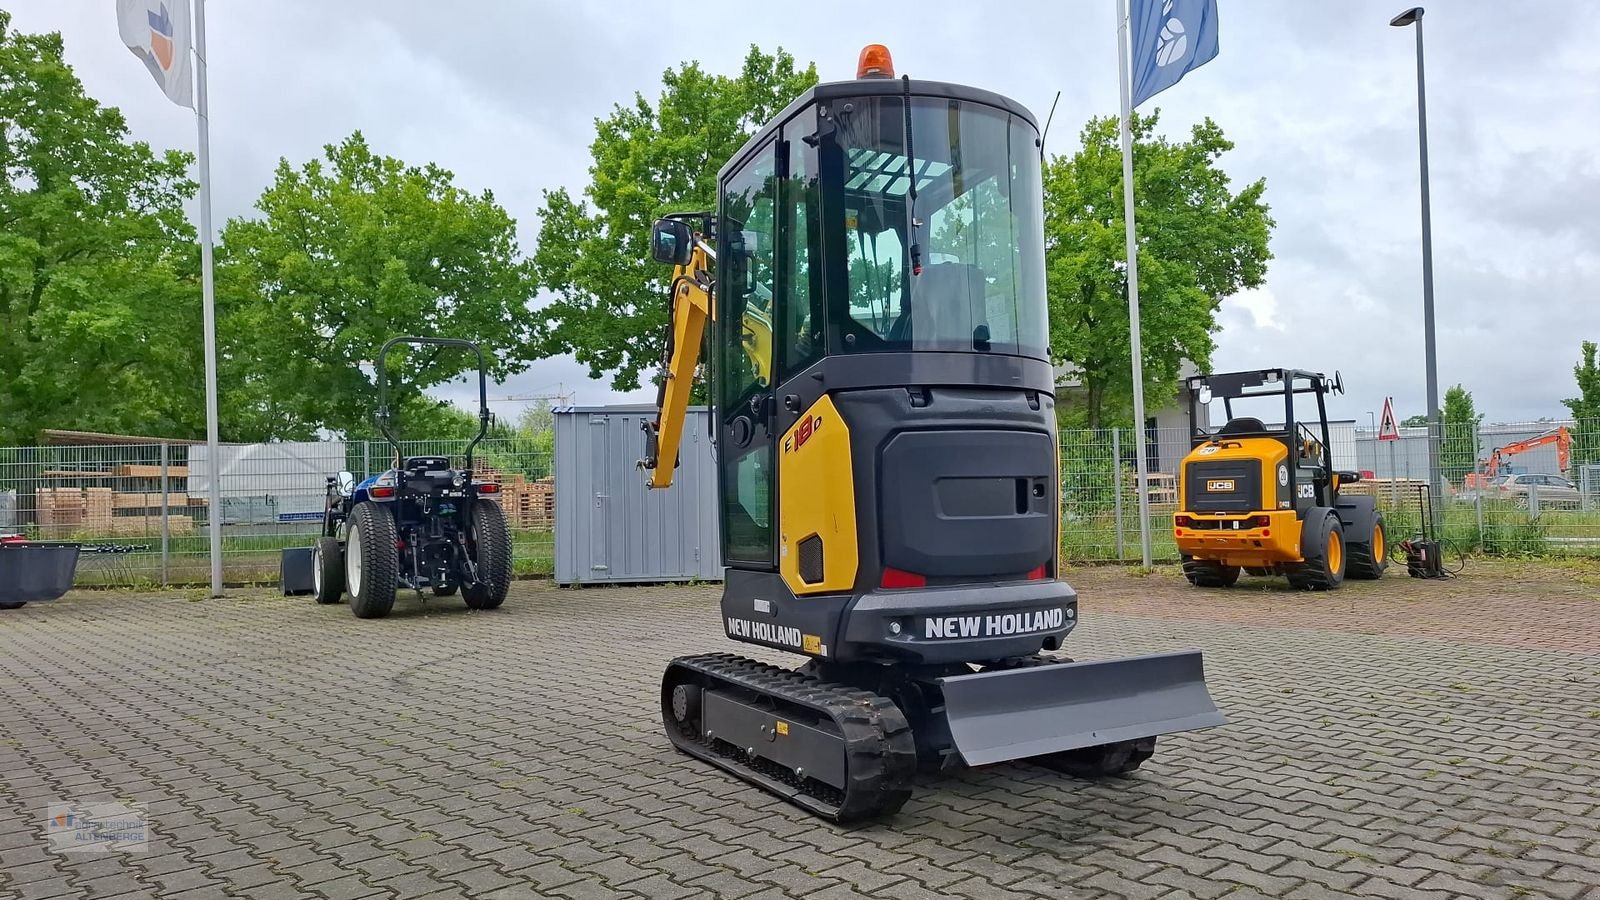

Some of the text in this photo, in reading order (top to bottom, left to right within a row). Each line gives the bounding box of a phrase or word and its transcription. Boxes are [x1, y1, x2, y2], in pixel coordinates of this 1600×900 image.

[1209, 481, 1233, 489] JCB
[1297, 484, 1315, 499] JCB
[727, 617, 751, 638] NEW
[751, 621, 802, 648] HOLLAND
[925, 607, 1063, 638] NEW HOLLAND
